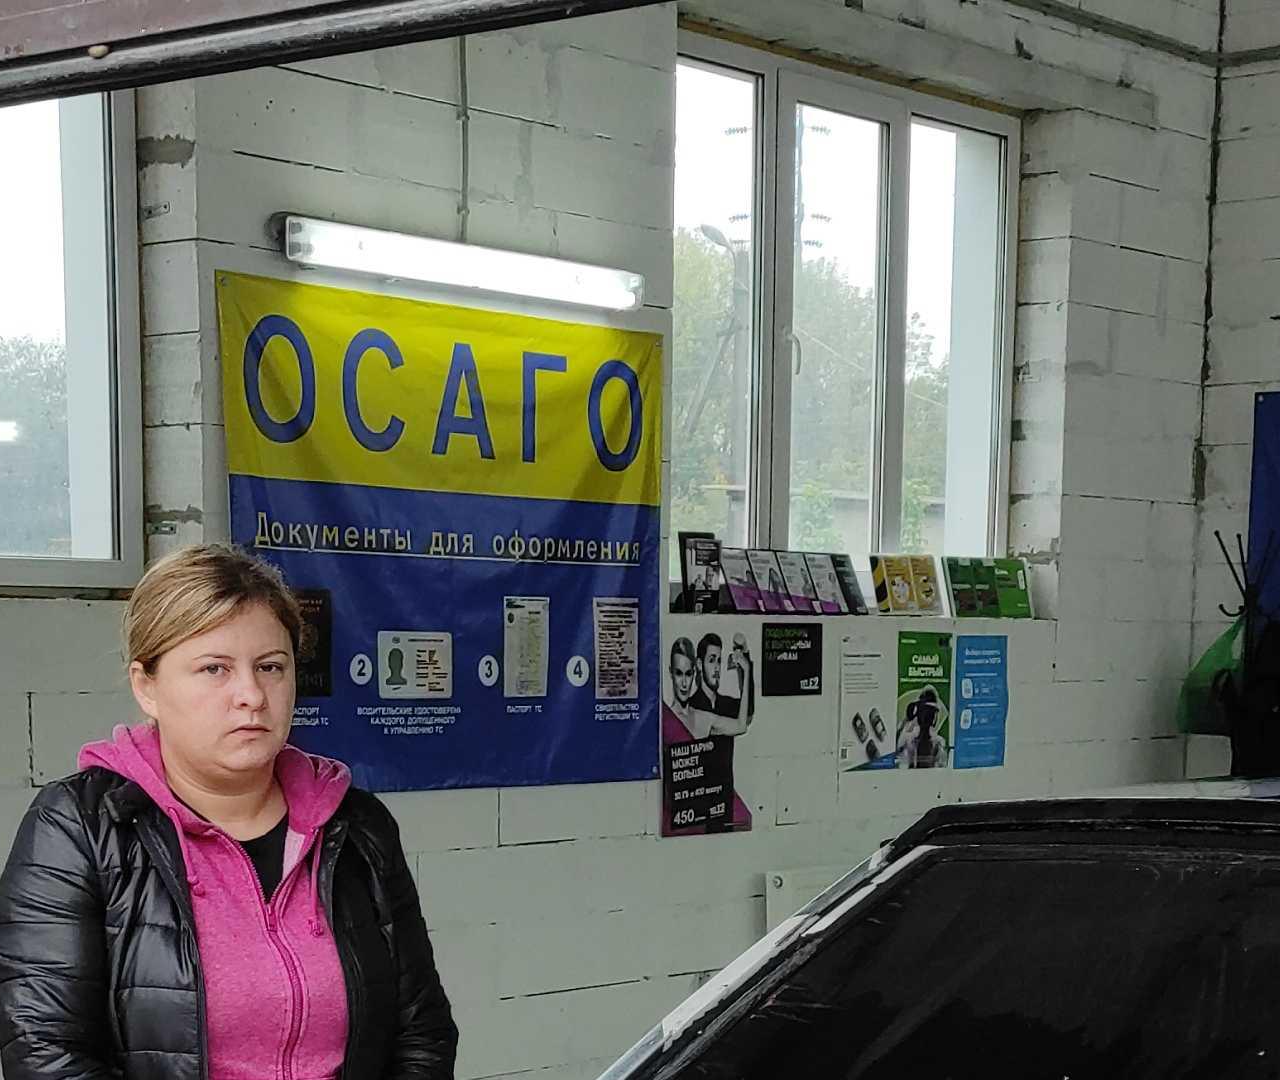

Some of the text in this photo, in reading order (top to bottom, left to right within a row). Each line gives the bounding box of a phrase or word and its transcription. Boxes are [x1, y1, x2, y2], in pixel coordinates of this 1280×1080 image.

[243, 314, 644, 472] ОСАГО
[255, 512, 641, 565] Документы для оформления
[357, 658, 367, 677] 2
[484, 661, 493, 679] 3
[573, 660, 583, 678] 4
[671, 746, 689, 757] НАШ
[672, 756, 699, 769] МОЖЕТ
[673, 809, 694, 824] 450
